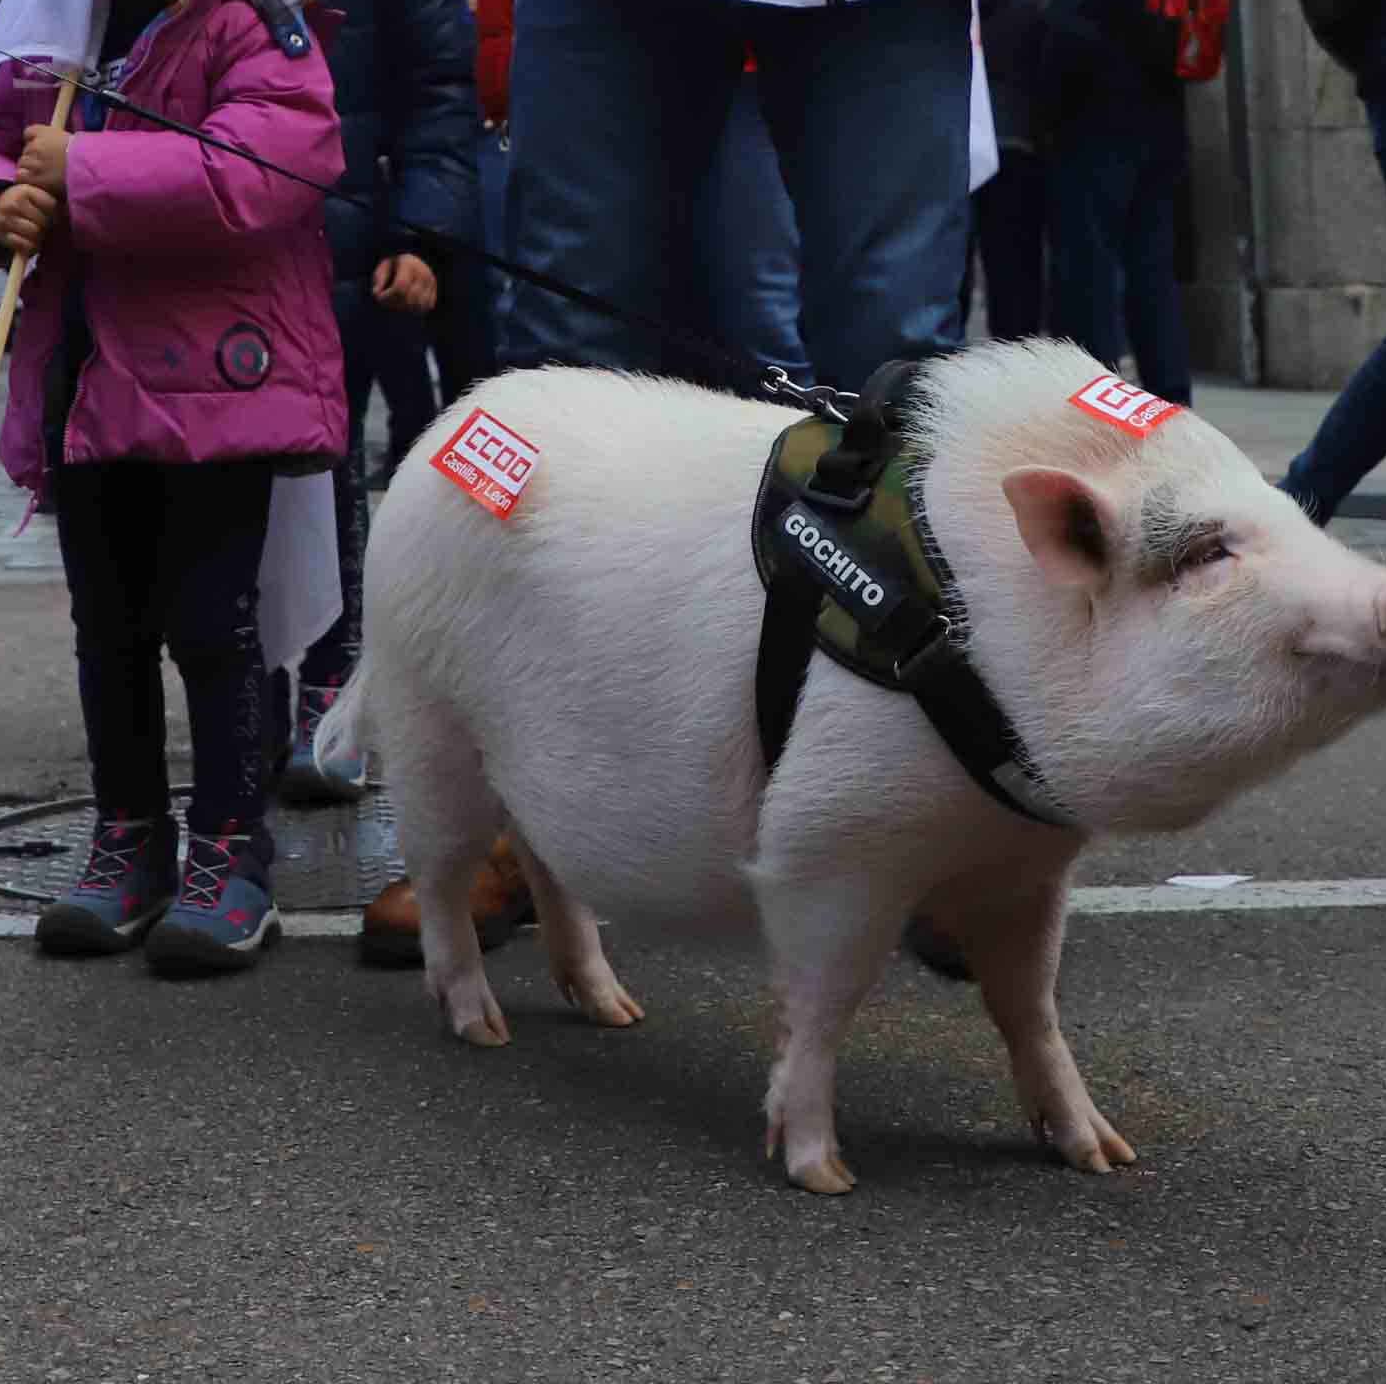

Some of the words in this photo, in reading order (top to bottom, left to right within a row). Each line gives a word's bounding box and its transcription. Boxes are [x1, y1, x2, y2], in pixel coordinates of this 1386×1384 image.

[441, 451, 479, 486] Castilla
[483, 482, 512, 511] León
[464, 426, 533, 484] CCOO
[785, 514, 884, 606] GOCHITO
